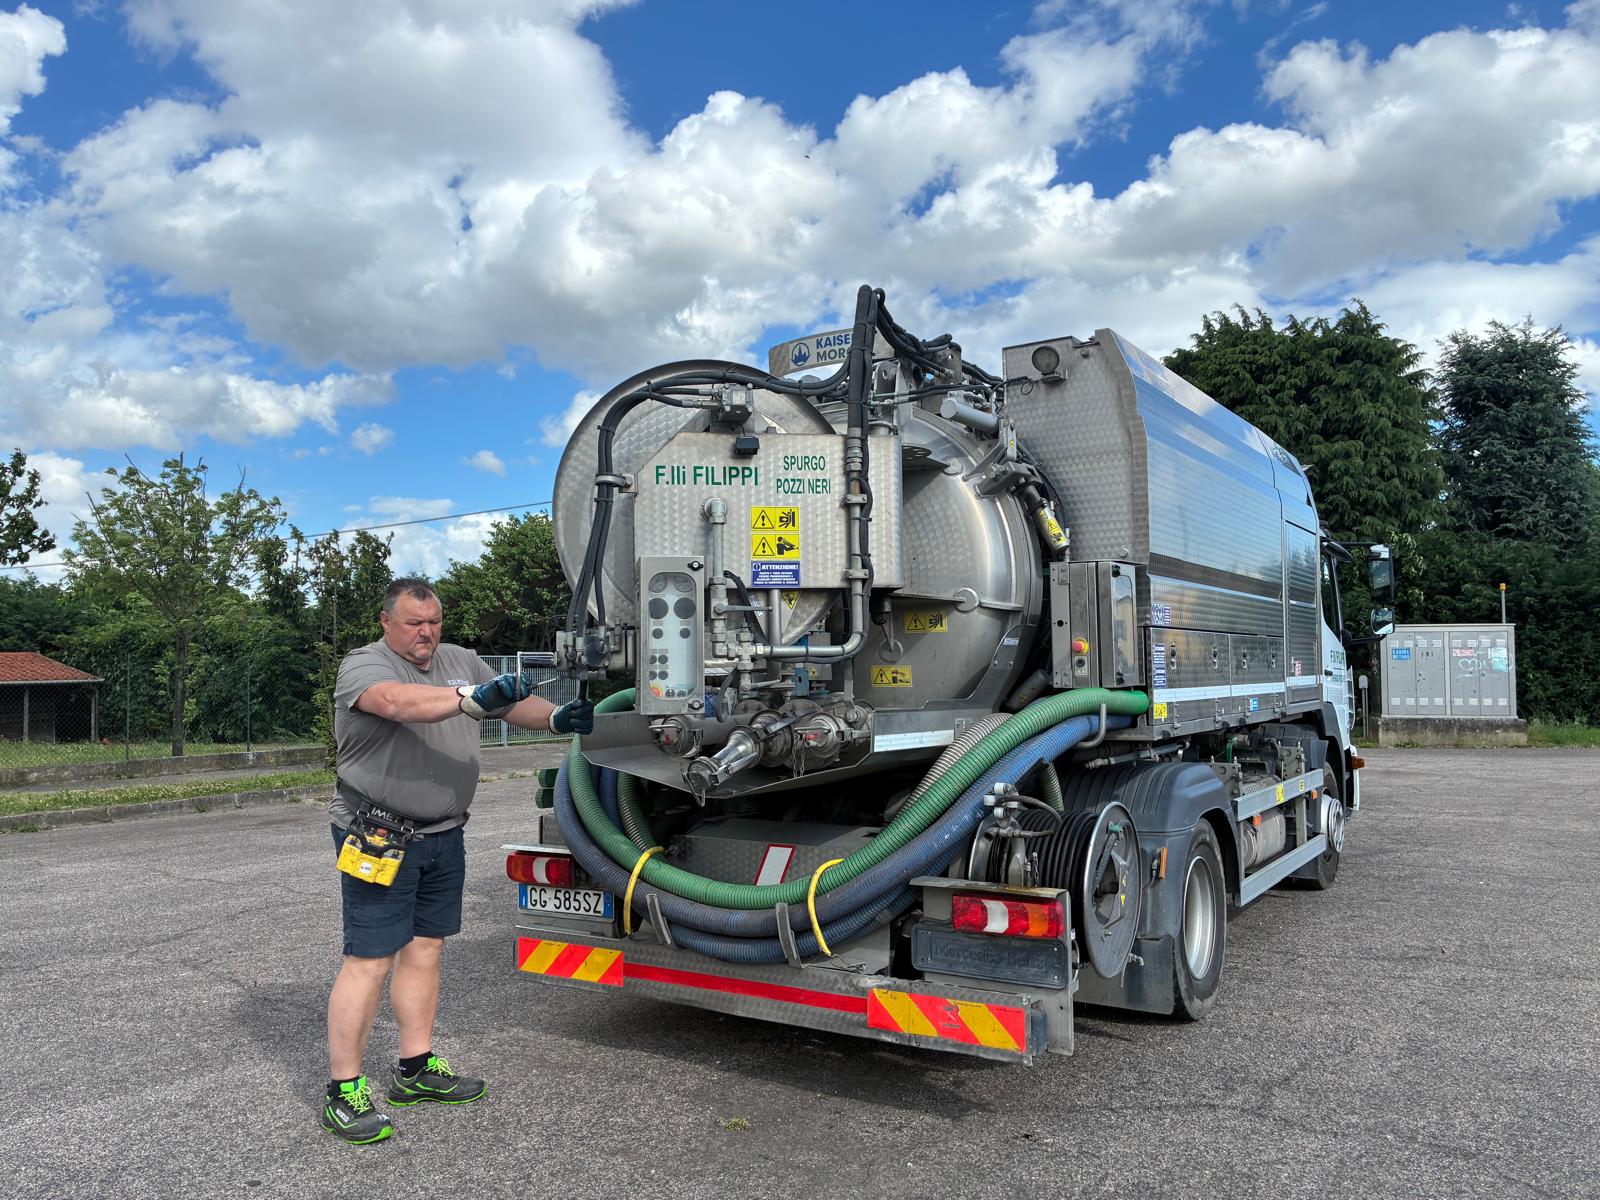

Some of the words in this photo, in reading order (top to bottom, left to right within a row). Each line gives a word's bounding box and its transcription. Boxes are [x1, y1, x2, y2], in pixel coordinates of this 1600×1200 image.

[816, 333, 852, 349] KAISE
[816, 347, 851, 362] MOR
[783, 455, 826, 471] SPURGO
[655, 465, 686, 486] F.lli
[693, 465, 759, 486] FILIPPI
[776, 478, 805, 495] POZZI
[808, 478, 831, 495] NERI
[529, 887, 547, 908] GG
[553, 889, 602, 914] 585SZ
